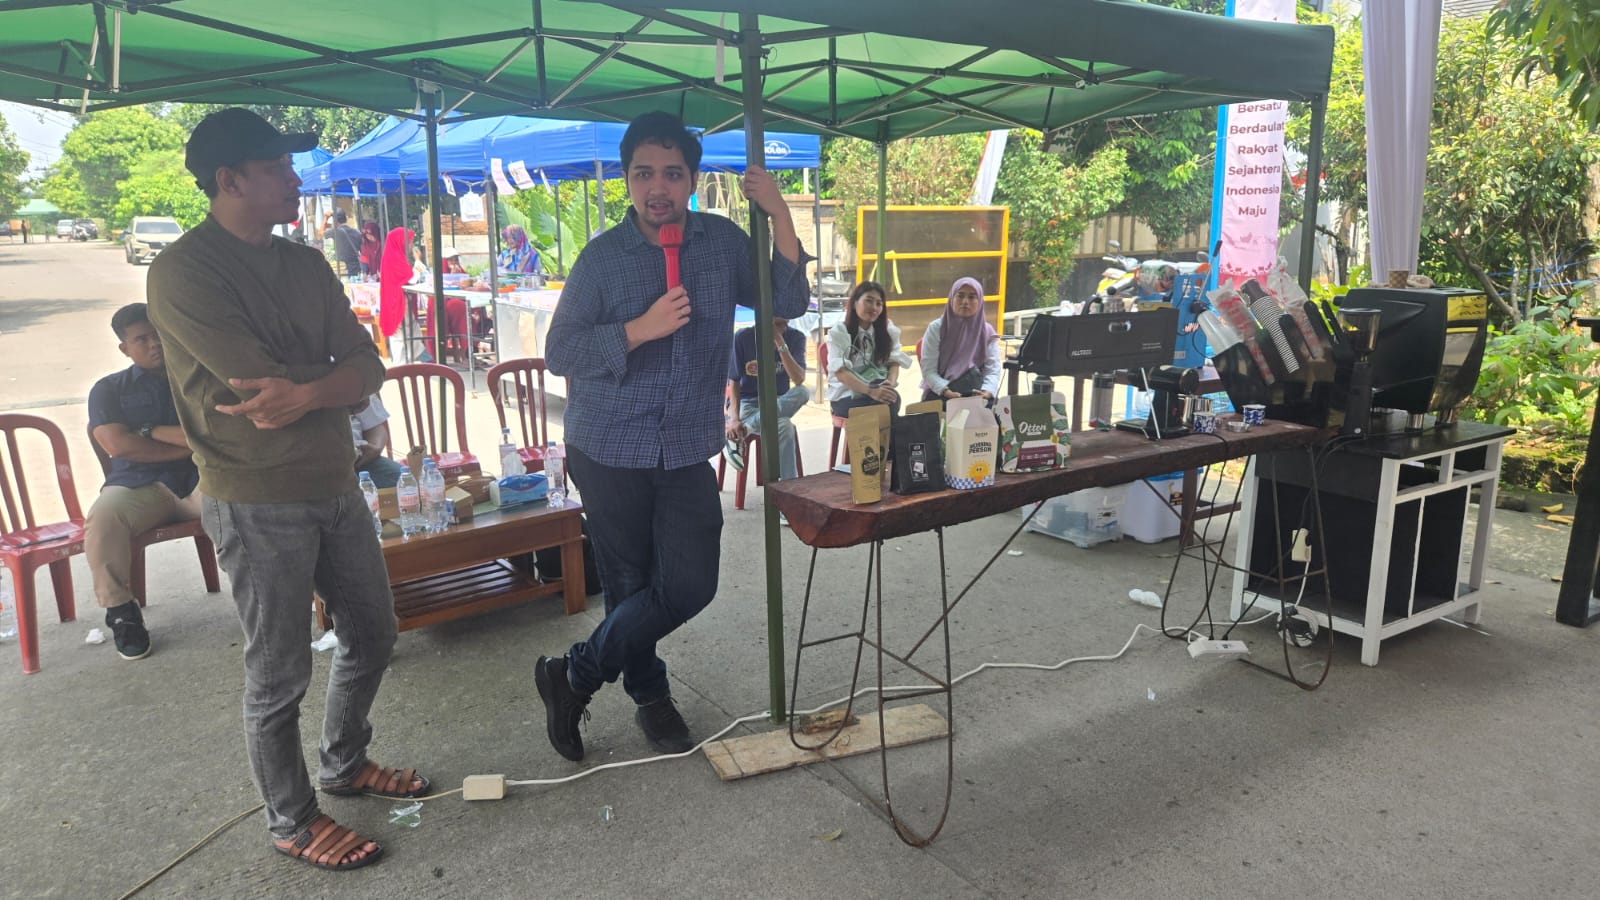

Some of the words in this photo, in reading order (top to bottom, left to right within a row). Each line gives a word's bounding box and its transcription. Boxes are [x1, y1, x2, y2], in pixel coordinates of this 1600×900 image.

[1237, 102, 1282, 113] Bersatu
[1237, 143, 1278, 156] Rakyat
[1226, 184, 1280, 196] Indonesia
[1238, 205, 1267, 218] Maju
[1018, 421, 1047, 434] Otten
